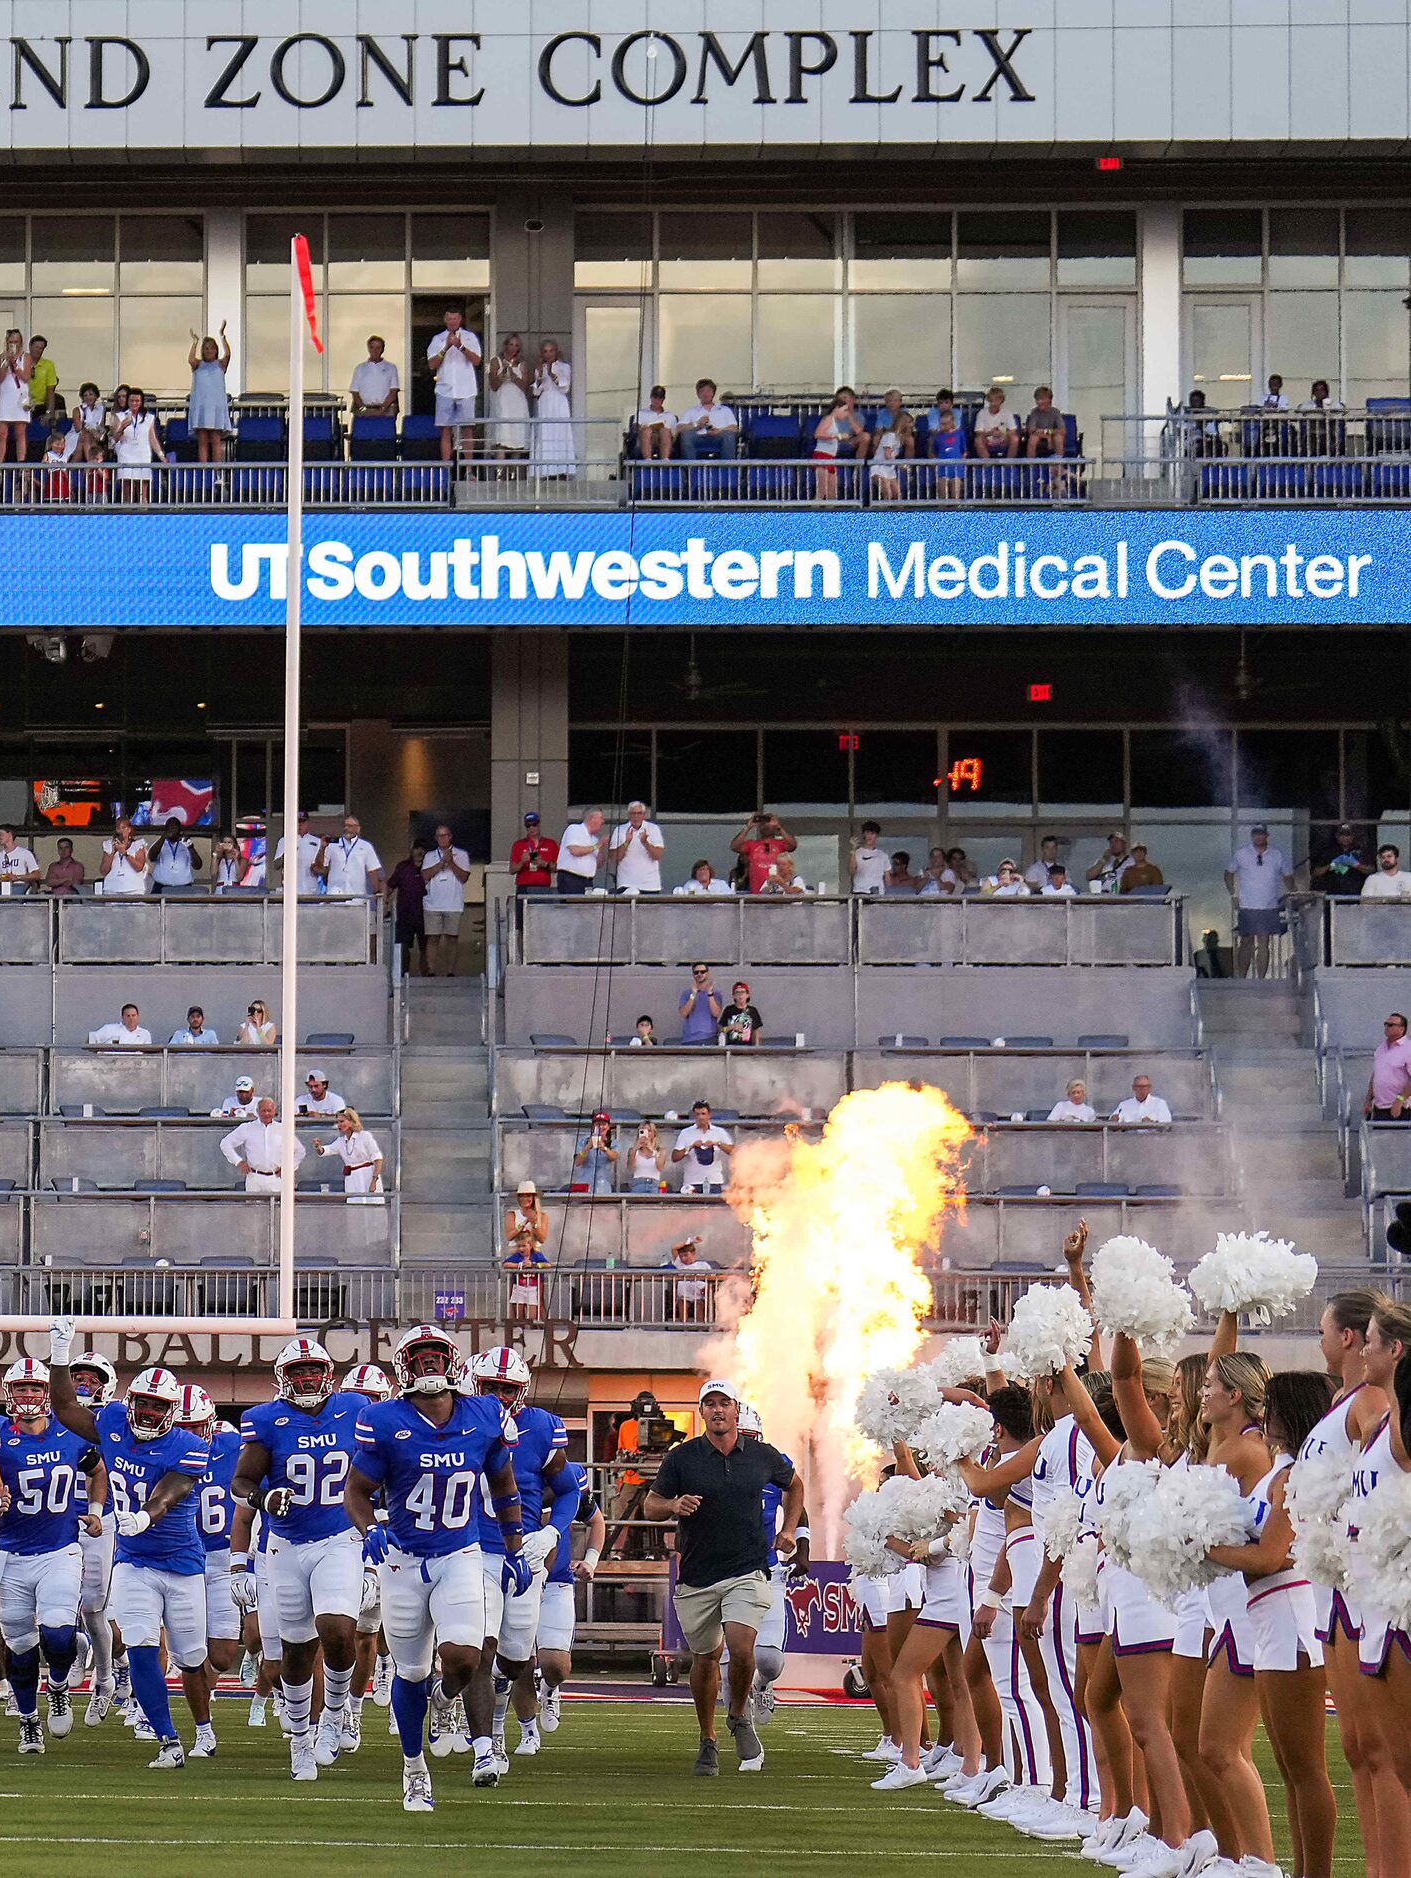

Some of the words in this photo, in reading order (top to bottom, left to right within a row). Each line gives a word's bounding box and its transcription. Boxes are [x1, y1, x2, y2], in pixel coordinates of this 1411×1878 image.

[205, 33, 484, 109] ZONE
[539, 29, 1035, 107] COMPLEX
[868, 541, 1127, 600] Medical
[1146, 540, 1373, 599] Center
[707, 1382, 726, 1390] SMU
[26, 1450, 61, 1467] SMU
[297, 1433, 337, 1449] SMU
[419, 1452, 465, 1468] SMU
[16, 1464, 74, 1515] 50
[113, 1456, 146, 1478] SMU
[286, 1450, 349, 1507] 92
[405, 1470, 476, 1531] 40
[823, 1581, 863, 1633] SM
